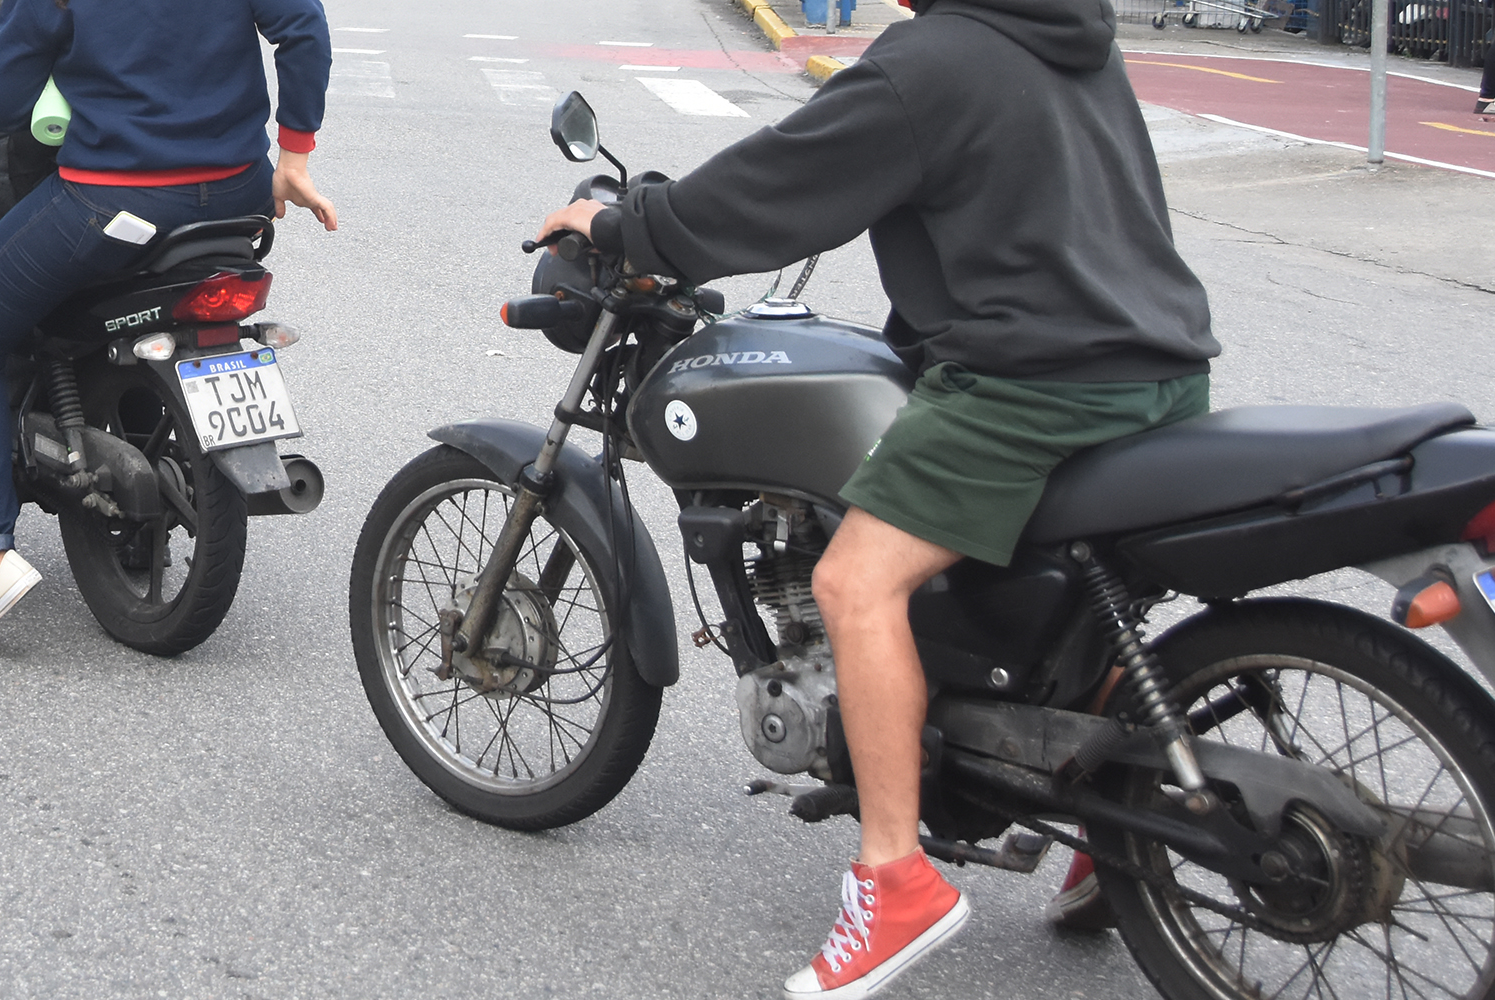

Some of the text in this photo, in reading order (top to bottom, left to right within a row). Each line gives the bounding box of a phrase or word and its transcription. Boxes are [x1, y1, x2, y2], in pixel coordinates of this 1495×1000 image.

[105, 306, 161, 332] SPORT
[209, 360, 246, 373] BRASIL
[667, 350, 792, 375] HONDA
[204, 370, 267, 406] TJM
[208, 401, 285, 441] 9C04
[203, 434, 216, 447] BR
